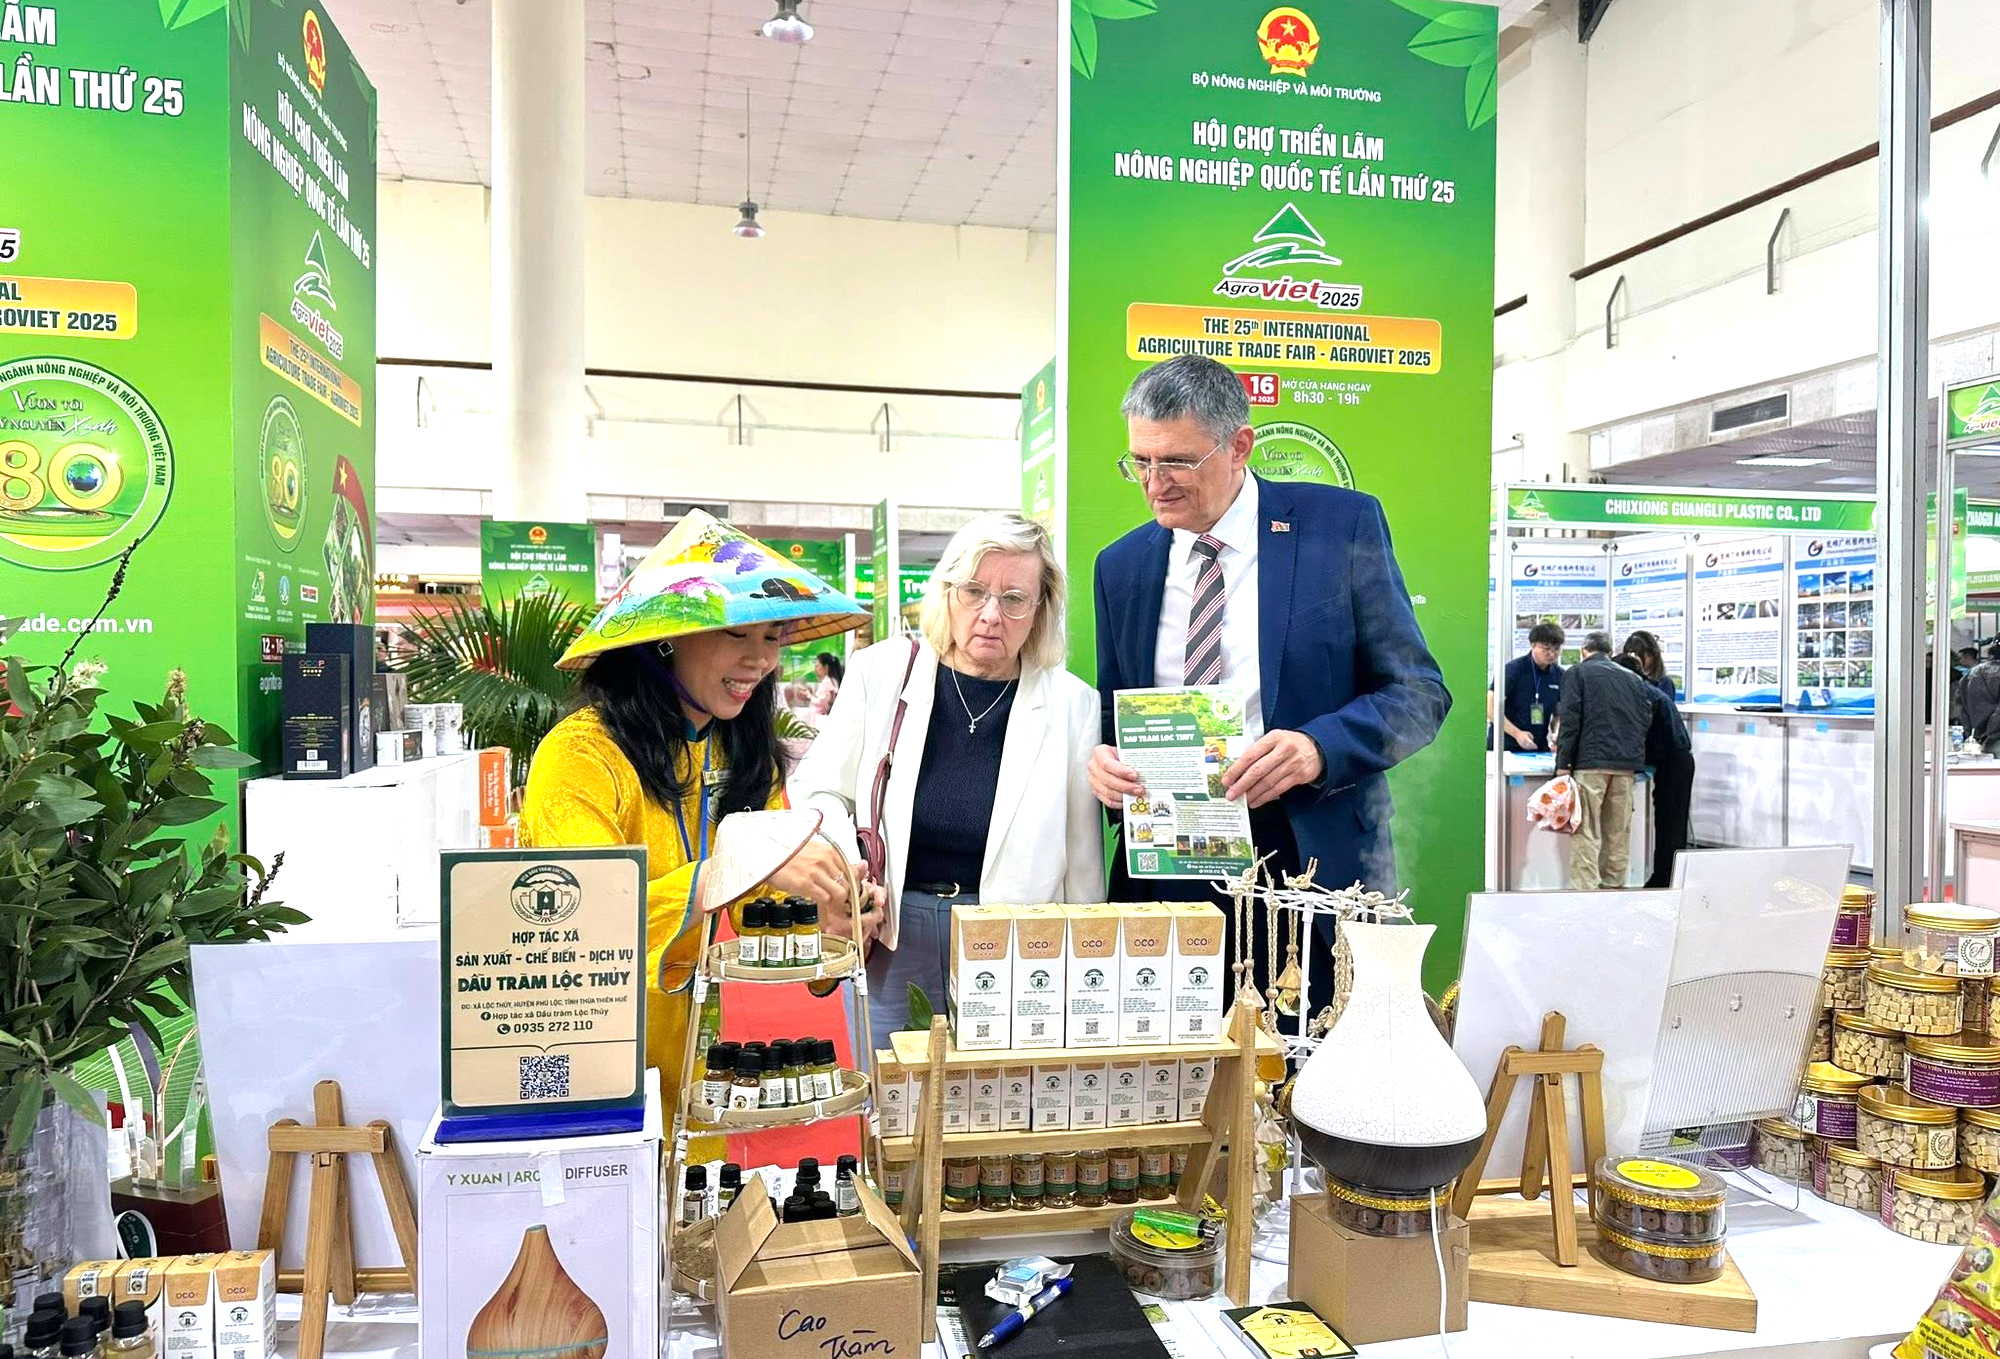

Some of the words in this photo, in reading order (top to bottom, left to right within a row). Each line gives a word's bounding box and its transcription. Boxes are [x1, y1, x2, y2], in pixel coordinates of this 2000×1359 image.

[70, 67, 137, 112] THỨ
[143, 78, 184, 117] 25
[1192, 72, 1209, 88] BỘ
[1212, 74, 1245, 91] NÔNG
[1247, 78, 1291, 95] NGHIỆP
[1293, 82, 1308, 96] VÀ
[1310, 83, 1332, 98] MÔI
[1335, 87, 1382, 102] TRƯỜNG
[277, 89, 293, 137] HỘI
[294, 110, 311, 161] CHỢ
[1193, 117, 1227, 152] HỘI
[1233, 124, 1274, 156] CHỢ
[1280, 123, 1337, 157] TRIỂN
[1342, 131, 1384, 162] LÃM
[242, 101, 271, 163] NÔNG
[272, 135, 304, 198] NGHIỆP
[305, 172, 326, 221] QUỐC
[1114, 148, 1173, 181] NÔNG
[1179, 158, 1254, 191] NGHIỆP
[1261, 160, 1314, 193] QUỐC
[1319, 164, 1343, 194] TẾ
[1347, 165, 1385, 198] LẦN
[1390, 172, 1428, 201] THỨ
[1432, 180, 1455, 203] 25
[1320, 291, 1360, 307] 2025
[67, 312, 117, 332] 2025
[1204, 318, 1229, 334] THE
[1234, 319, 1259, 336] 25th
[1263, 321, 1370, 342] INTERNATIONAL
[1138, 337, 1233, 357] AGRICULTURE
[1238, 342, 1282, 359] TRADE
[1285, 343, 1316, 361] FAIR
[1330, 346, 1395, 365] AGROVIET
[1399, 351, 1431, 366] 2025
[36, 362, 66, 375] NÔNG
[68, 365, 106, 385] NGHIỆP
[105, 381, 119, 395] VÀ
[1250, 375, 1274, 395] 16
[118, 390, 138, 409] MÔI
[1294, 391, 1324, 404] 8h30
[1338, 392, 1359, 405] 19h
[134, 405, 160, 442] TRƯỜNG
[1275, 425, 1294, 435] NÔNG
[1294, 427, 1317, 442] NGHIỆP
[1317, 438, 1326, 448] VÀ
[152, 442, 168, 462] VIỆT
[155, 466, 167, 486] NAM
[1605, 498, 1668, 516] CHUXIONG
[1671, 501, 1722, 518] GUANGLI
[1725, 503, 1774, 520] PLASTIC
[1776, 505, 1799, 522] CO.,
[1801, 507, 1821, 521] LTD
[10, 613, 152, 633] ade.com.vn
[262, 637, 271, 654] 12
[260, 671, 283, 695] agritra
[512, 930, 535, 946] HỢP
[539, 928, 559, 944] TÁC
[563, 928, 580, 942] XÃ
[455, 951, 479, 967] SẢN
[482, 949, 513, 966] XUẤT
[526, 947, 549, 964] CHẾ
[551, 945, 576, 963] BIẾN
[589, 949, 615, 965] DỊCH
[617, 948, 633, 964] VỤ
[457, 973, 492, 992] DẦU
[552, 970, 583, 991] LỘC
[588, 967, 631, 987] THỦY
[492, 1011, 508, 1021] Hợp
[510, 1010, 523, 1019] tác
[574, 1008, 589, 1017] Lộc
[514, 1022, 545, 1034] 0935
[549, 1021, 570, 1032] 272
[573, 1020, 593, 1031] 110
[447, 1174, 456, 1186] Y
[460, 1173, 502, 1185] XUAN
[514, 1170, 541, 1183] ARO
[565, 1164, 628, 1180] DIFFUSER
[778, 1309, 827, 1340] Cao
